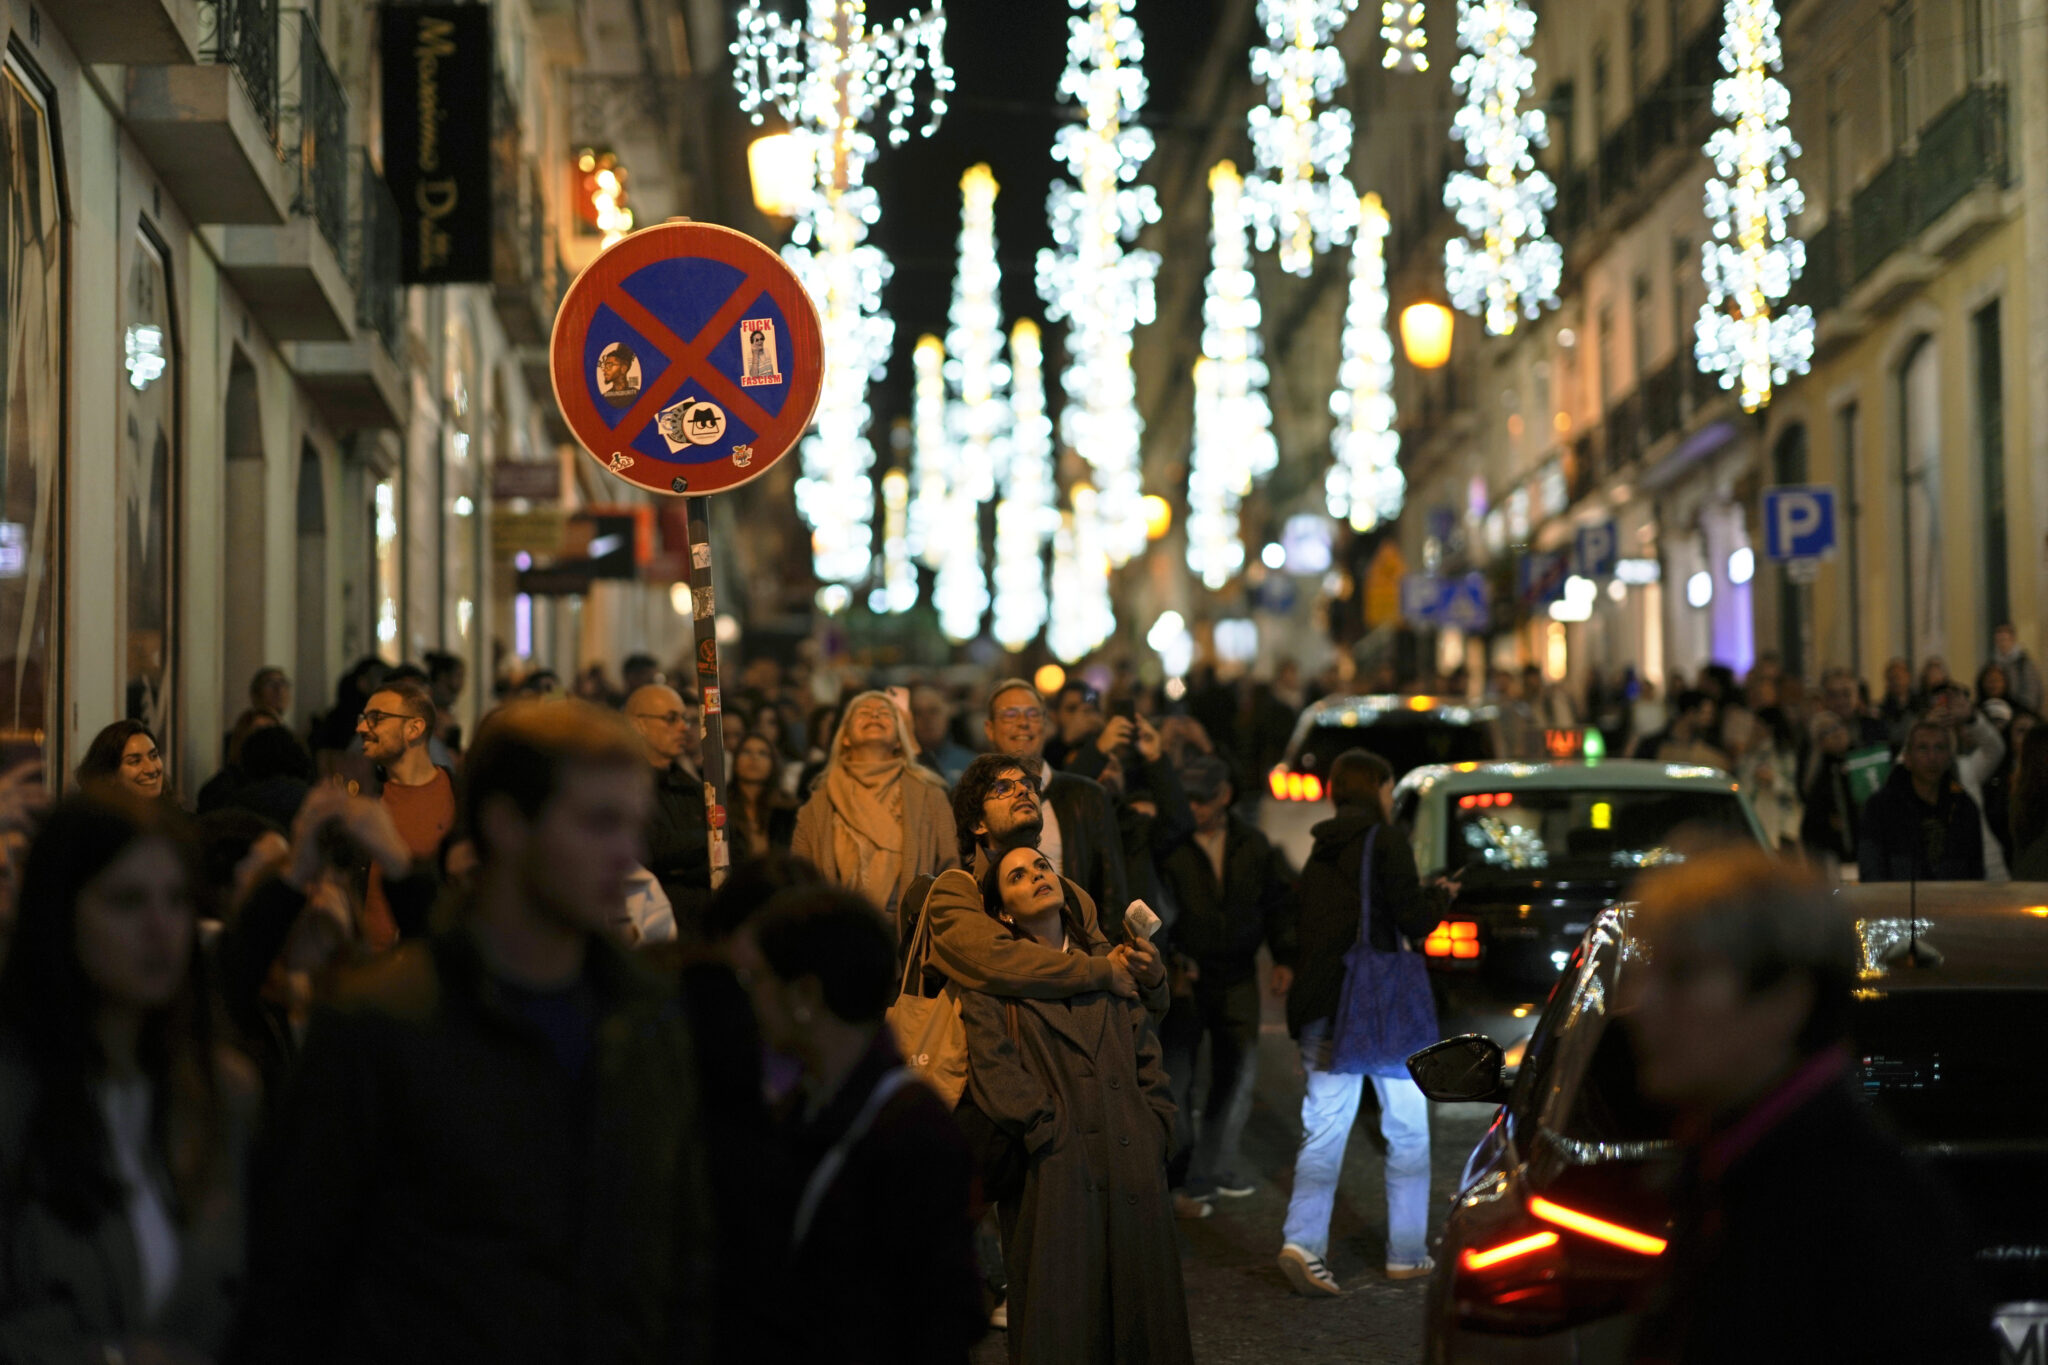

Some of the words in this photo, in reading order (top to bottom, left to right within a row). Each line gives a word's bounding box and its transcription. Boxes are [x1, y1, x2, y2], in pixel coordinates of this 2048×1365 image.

[742, 319, 772, 333] FUCK
[741, 374, 781, 387] FASCISM
[1778, 491, 1822, 556] P
